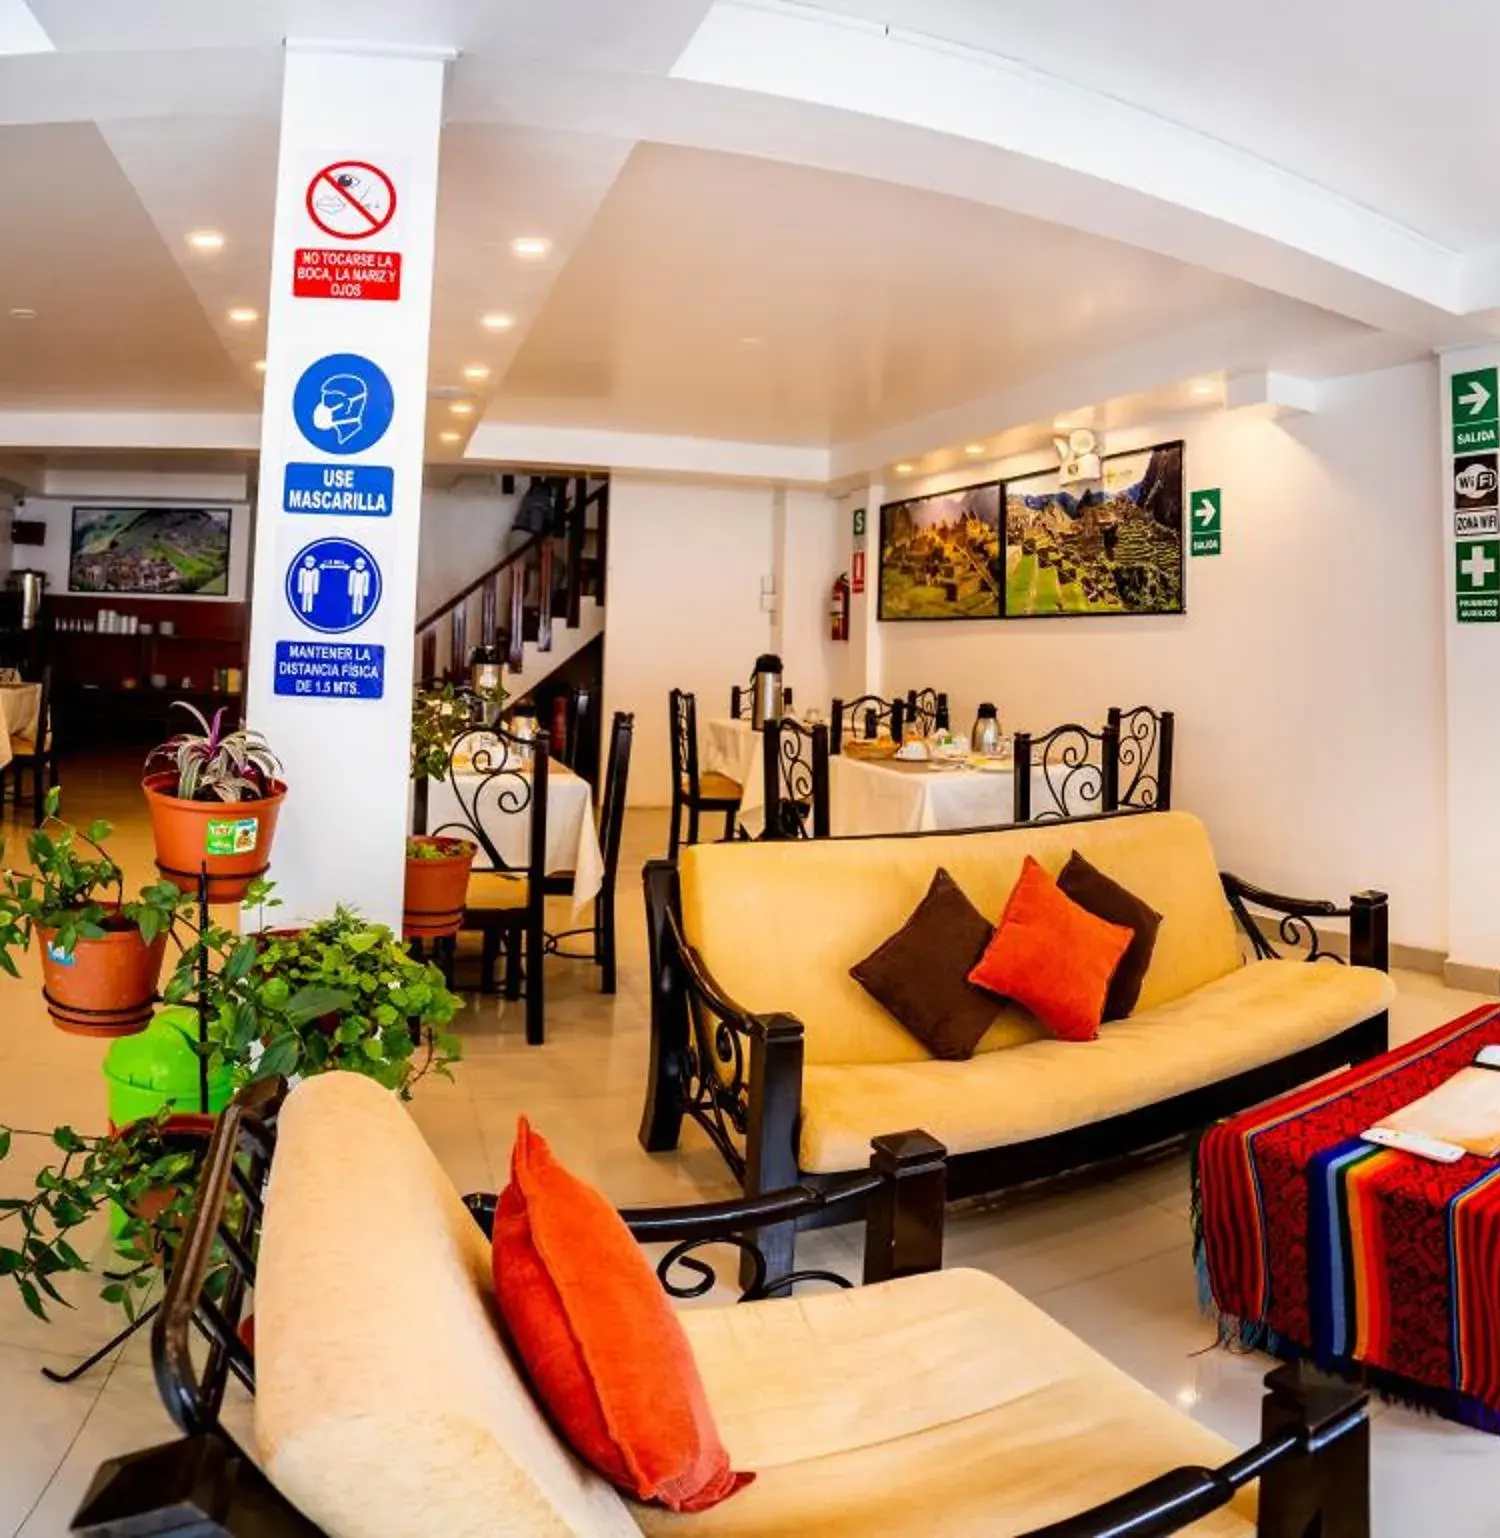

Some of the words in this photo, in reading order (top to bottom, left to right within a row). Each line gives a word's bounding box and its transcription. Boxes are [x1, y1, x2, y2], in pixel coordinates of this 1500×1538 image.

[303, 251, 320, 264] NO
[322, 252, 375, 267] TOCARSE
[377, 256, 393, 268] LA
[297, 267, 332, 281] BOCA,
[335, 268, 351, 280] LA
[353, 270, 387, 283] NARIZ
[389, 271, 397, 283] Y
[330, 283, 361, 296] OJOS
[1457, 429, 1496, 445] SALIDA
[323, 469, 355, 488] USE
[289, 489, 387, 512] MASCARILLA
[1457, 516, 1479, 531] ZONA
[289, 645, 352, 660] MANTENER
[355, 648, 371, 661] LA
[279, 661, 339, 676] DISTANCIA
[341, 661, 379, 678] FÍSICA
[295, 679, 312, 693] DE
[315, 681, 331, 693] 1.5
